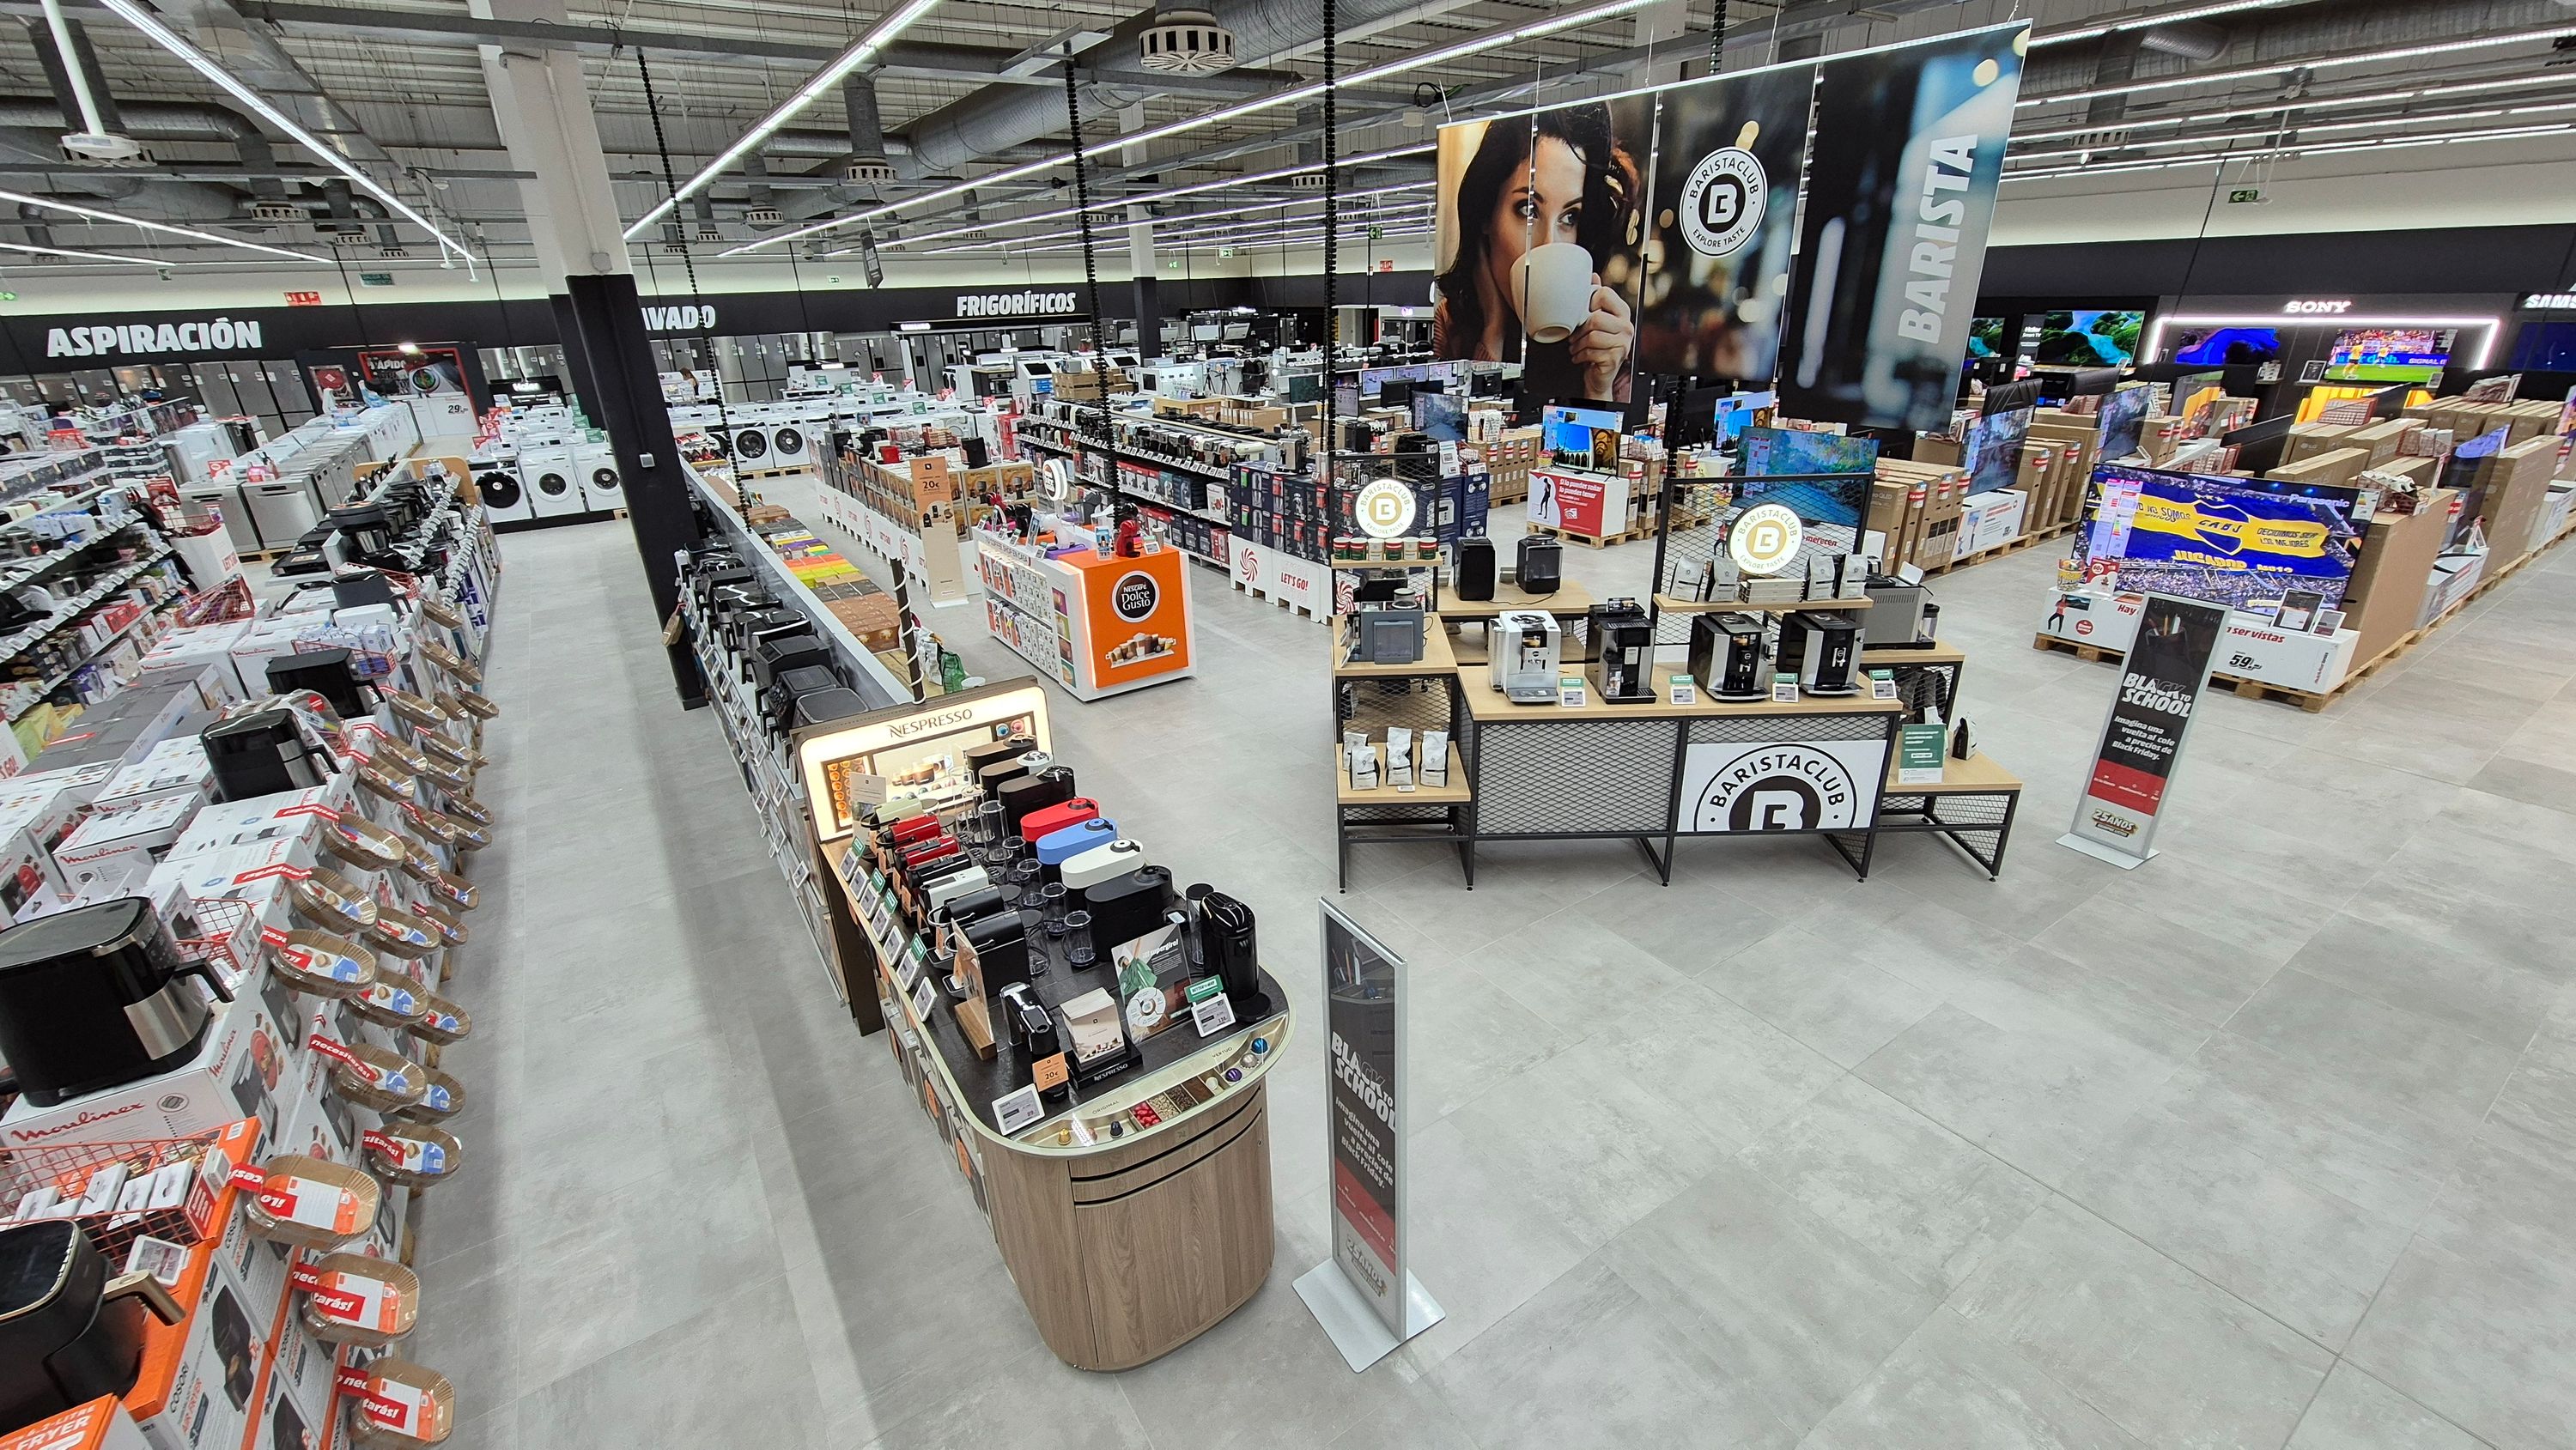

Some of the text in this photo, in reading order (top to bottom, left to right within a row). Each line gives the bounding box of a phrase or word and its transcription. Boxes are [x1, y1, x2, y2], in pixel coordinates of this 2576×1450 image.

[1689, 157, 1759, 198] BARISTACLUB
[1693, 226, 1746, 247] EXPLORE TASTE
[1898, 134, 1978, 344] BARISTA
[957, 290, 1076, 316] FRIGORÍFICOS
[2284, 300, 2351, 313] SONY
[47, 317, 262, 357] ASPIRACIÓN
[1360, 482, 1411, 506] BARISTACLUB
[2289, 494, 2350, 508] Panasonic
[1736, 509, 1797, 537] BARISTACLUB
[1280, 572, 1309, 592] LET'S GO!
[1122, 598, 1151, 610] Gusto
[2117, 604, 2136, 616] Hay
[2233, 627, 2252, 639] ser
[2254, 629, 2285, 644] vistas
[2123, 672, 2192, 702] BLACK TO
[2121, 688, 2192, 719] SCHOOL
[887, 709, 973, 737] NESPRESSO
[2114, 715, 2164, 734] Imagina una
[2121, 726, 2147, 738] vuelta
[2157, 737, 2175, 746] cole
[2112, 740, 2160, 760] Black Friday.
[2130, 738, 2161, 752] precios
[2161, 746, 2172, 755] de
[1710, 754, 1844, 808] BARISTACLUB
[60, 843, 138, 864] Moulinex
[1212, 1047, 1233, 1059] VERTUO
[1094, 1063, 1128, 1082] NESPRESSO
[1331, 1031, 1394, 1108] BLACK TO
[1092, 1101, 1120, 1114] ORIGINAL
[1334, 1057, 1397, 1133] SCHOOL
[11, 1101, 144, 1142] Moulinex
[1335, 1096, 1380, 1149] Imagina una
[1344, 1117, 1393, 1174] vuelta al cole
[1341, 1136, 1360, 1162] Black
[1360, 1157, 1385, 1189] Friday.
[1351, 1136, 1393, 1186] a precios de
[171, 1361, 189, 1413] COSORI
[16, 1415, 92, 1450] FRYER
